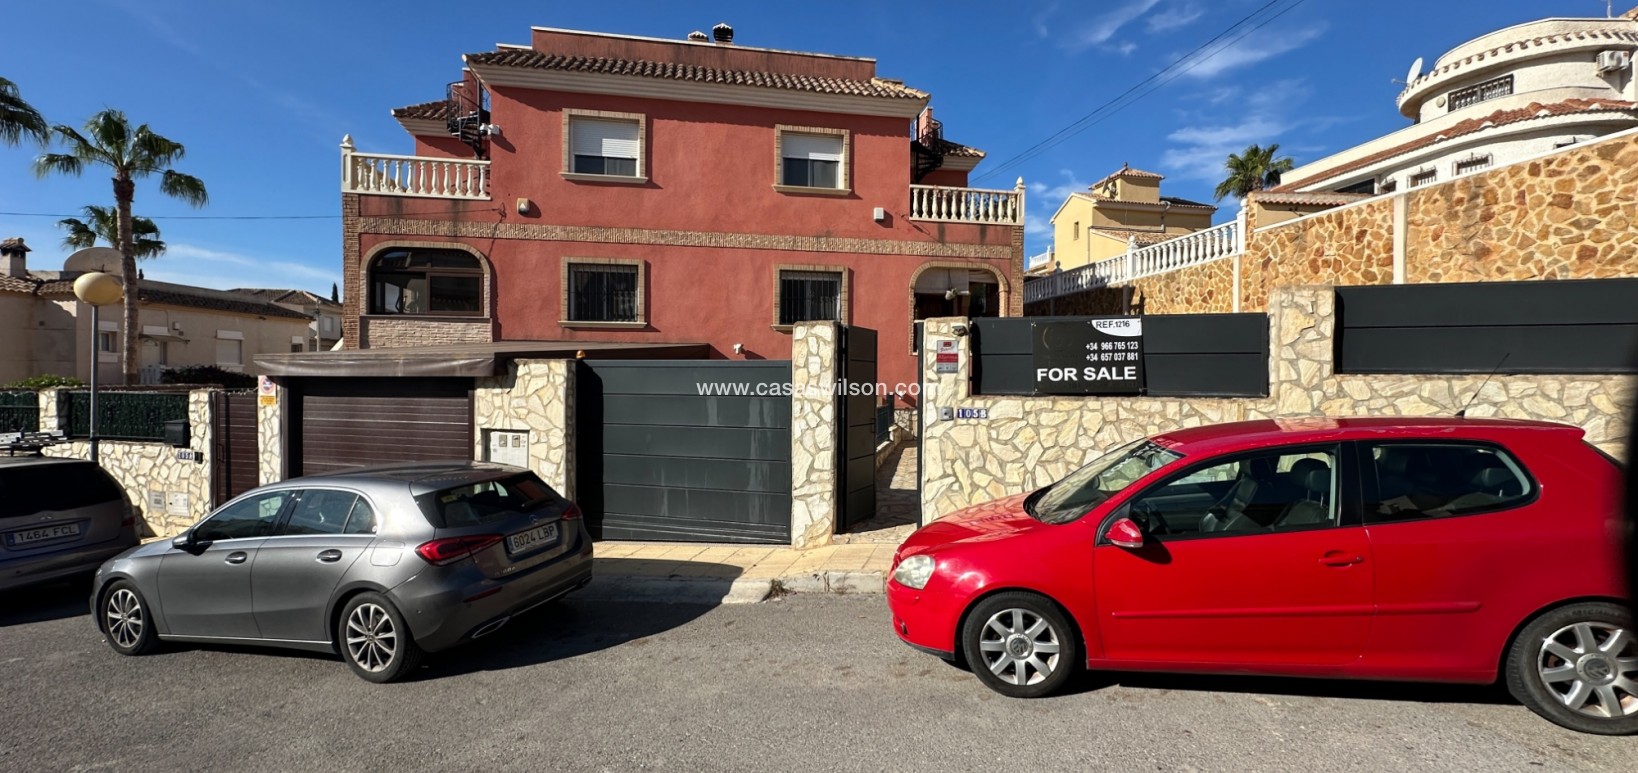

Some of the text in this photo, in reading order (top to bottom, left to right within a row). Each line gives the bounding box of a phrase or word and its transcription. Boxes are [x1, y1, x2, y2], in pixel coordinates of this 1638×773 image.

[1095, 320, 1130, 329] REF.1216
[1085, 341, 1139, 351] +34 966 765 123
[1085, 352, 1139, 361] +34 657 037 881
[1036, 366, 1137, 382] FOR SALE
[18, 525, 77, 542] 1464 FCL
[513, 525, 555, 548] 6024 LBP
